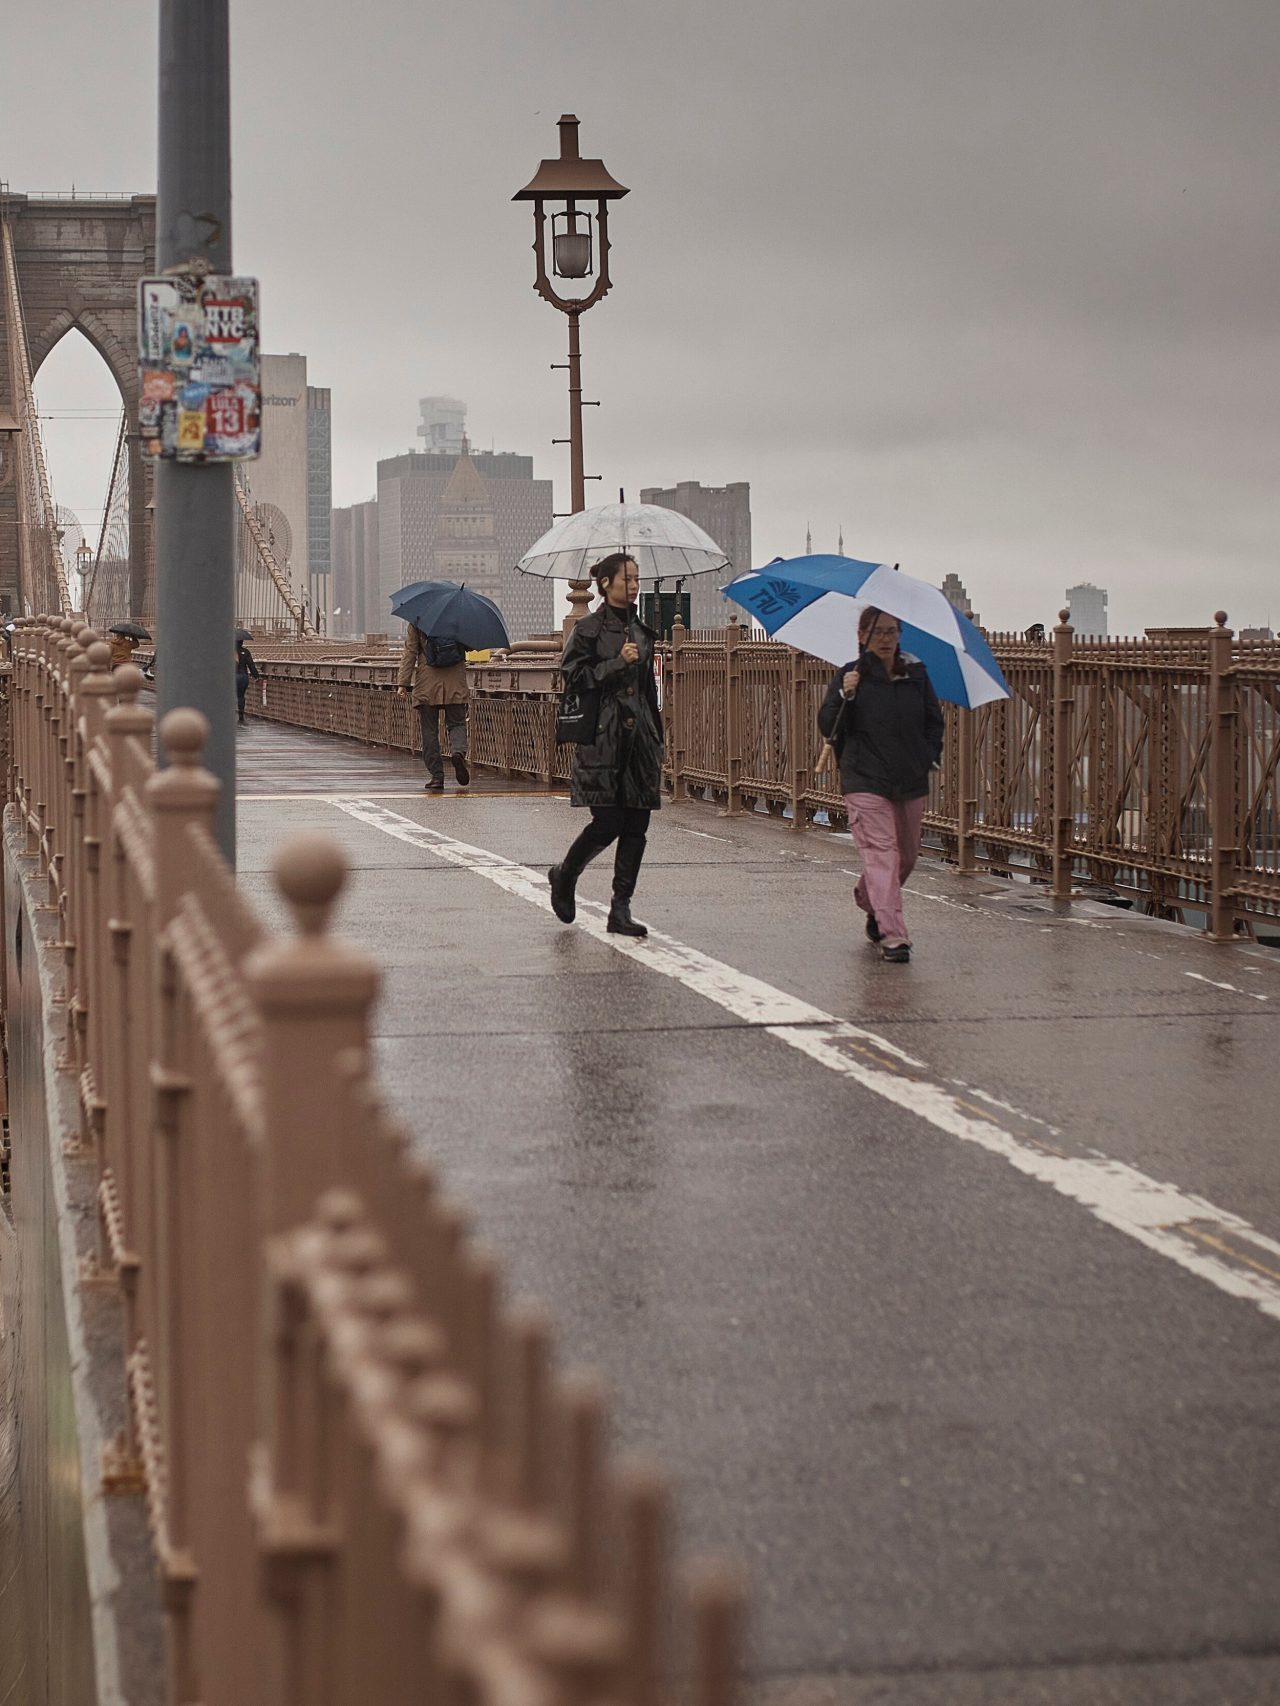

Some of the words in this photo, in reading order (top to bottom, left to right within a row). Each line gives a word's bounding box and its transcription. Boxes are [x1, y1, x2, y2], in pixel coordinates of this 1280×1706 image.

[205, 321, 245, 336] NYC
[261, 394, 298, 406] erizon
[211, 411, 238, 431] 13
